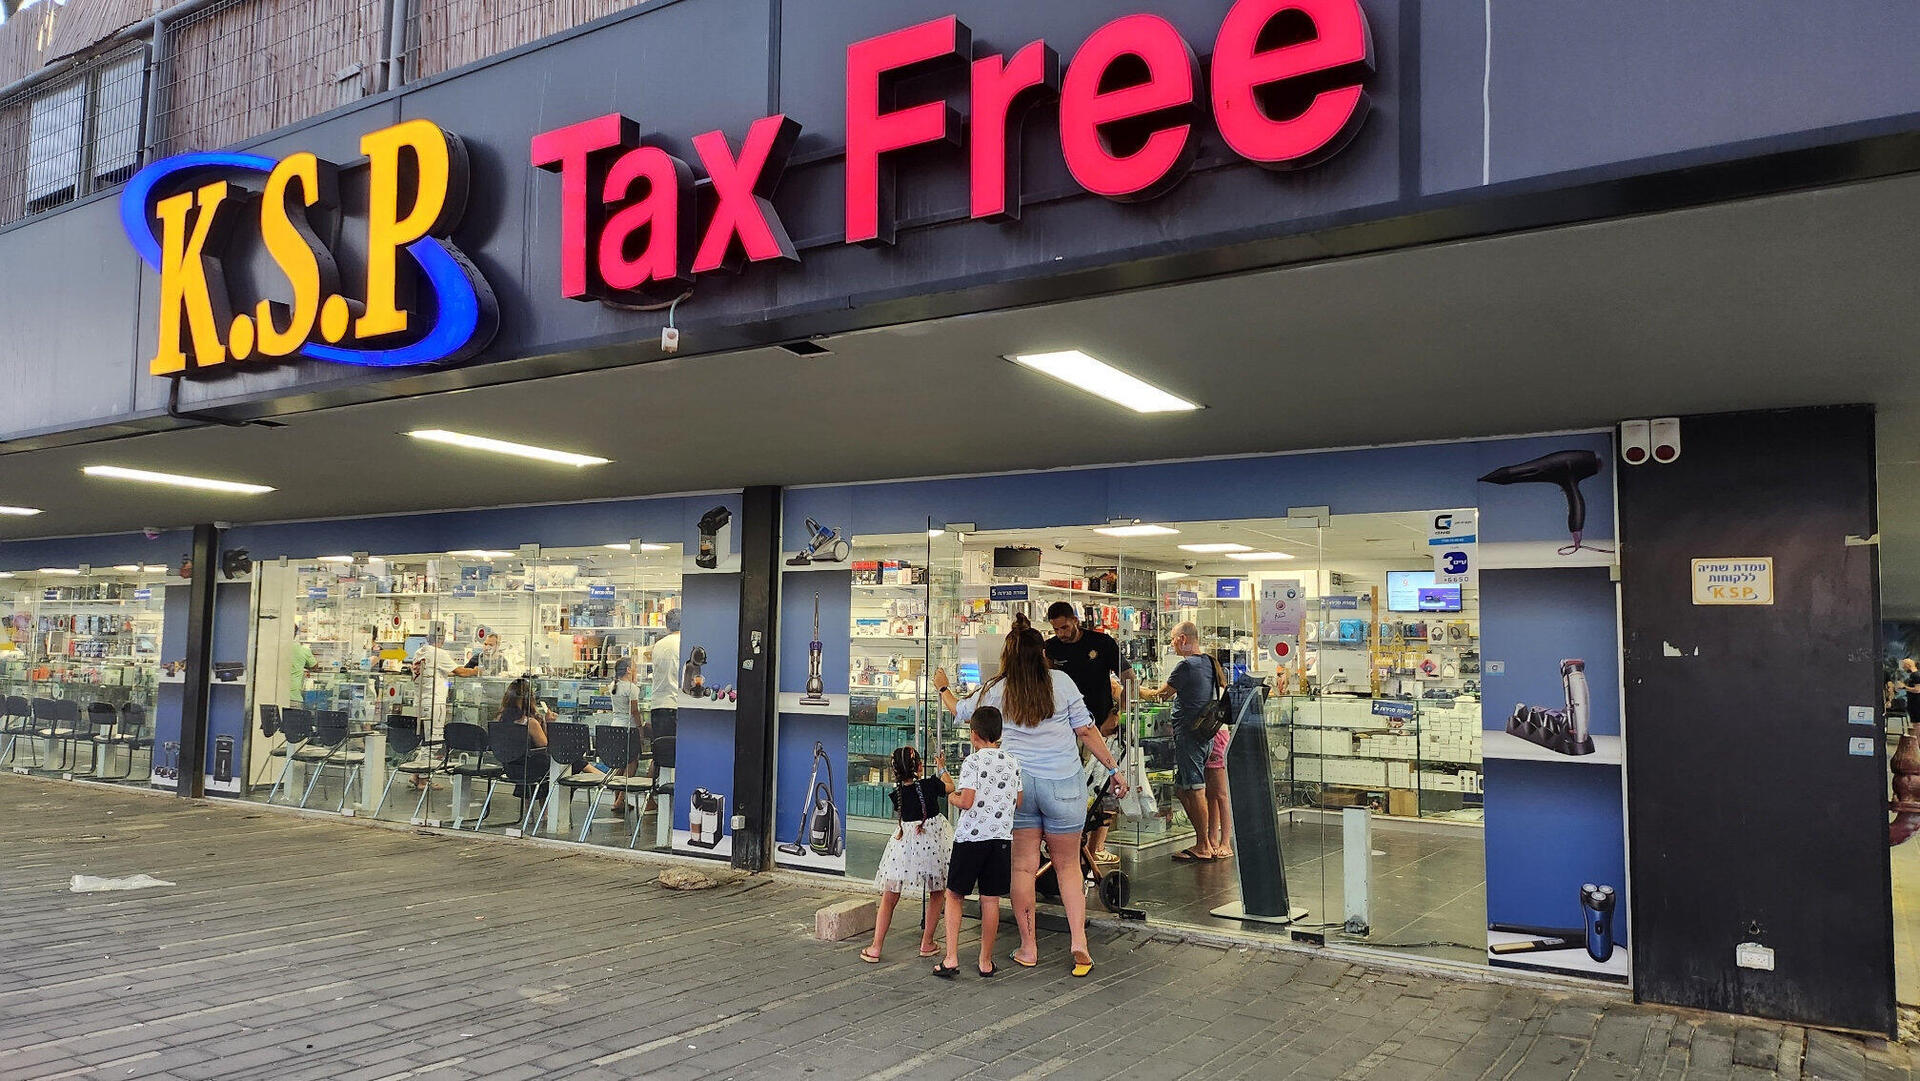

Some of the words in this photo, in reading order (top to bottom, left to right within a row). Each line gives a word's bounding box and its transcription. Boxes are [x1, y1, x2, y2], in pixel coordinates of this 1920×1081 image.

[531, 112, 790, 300] Tax
[845, 0, 1367, 244] Free
[150, 119, 450, 377] K.S.P
[1698, 564, 1729, 572] שתיה
[1733, 564, 1766, 572] עמדת
[1709, 573, 1756, 584] ללקוחות
[991, 588, 997, 596] 5
[1373, 703, 1379, 711] 2
